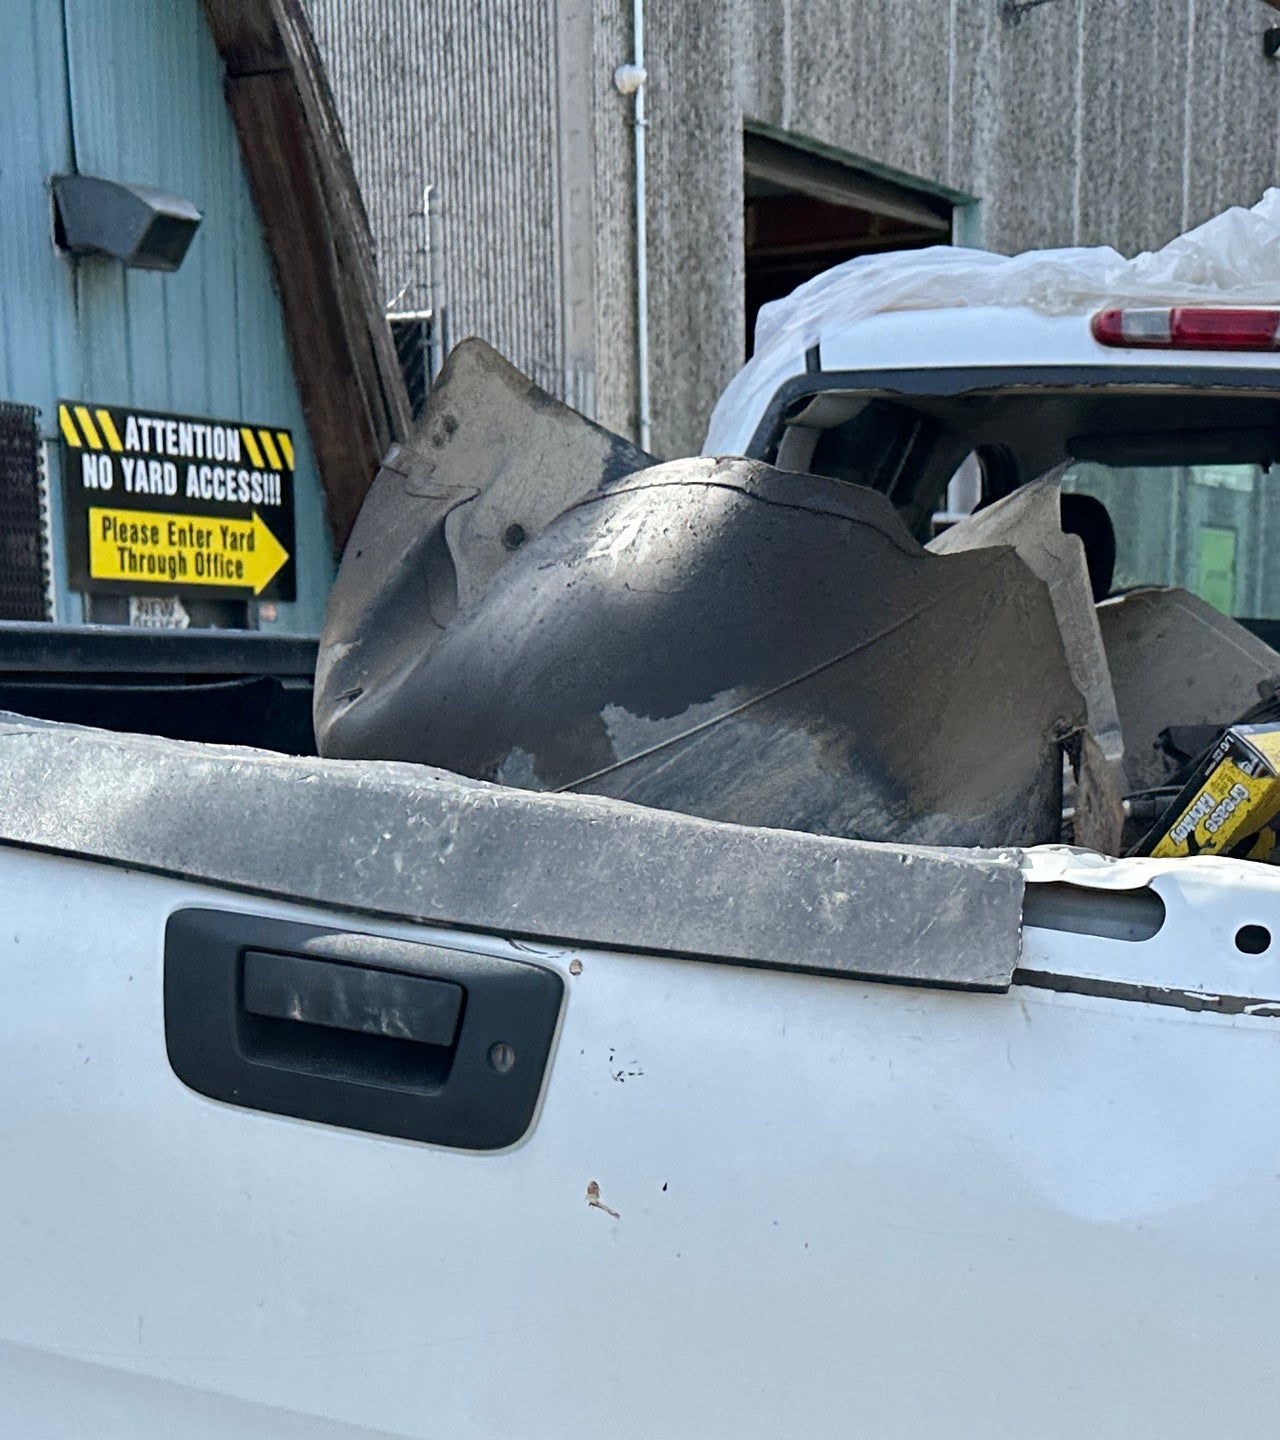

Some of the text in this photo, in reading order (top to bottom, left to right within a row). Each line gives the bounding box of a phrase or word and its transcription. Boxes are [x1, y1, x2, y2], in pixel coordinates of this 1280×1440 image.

[124, 415, 241, 463] ATTENTION
[81, 453, 282, 506] NO YARD ACCESS!!!
[101, 515, 256, 553] Please Enter Yard
[117, 546, 244, 580] Through Office
[1169, 792, 1217, 846] Monkey
[1204, 783, 1249, 833] Grease
